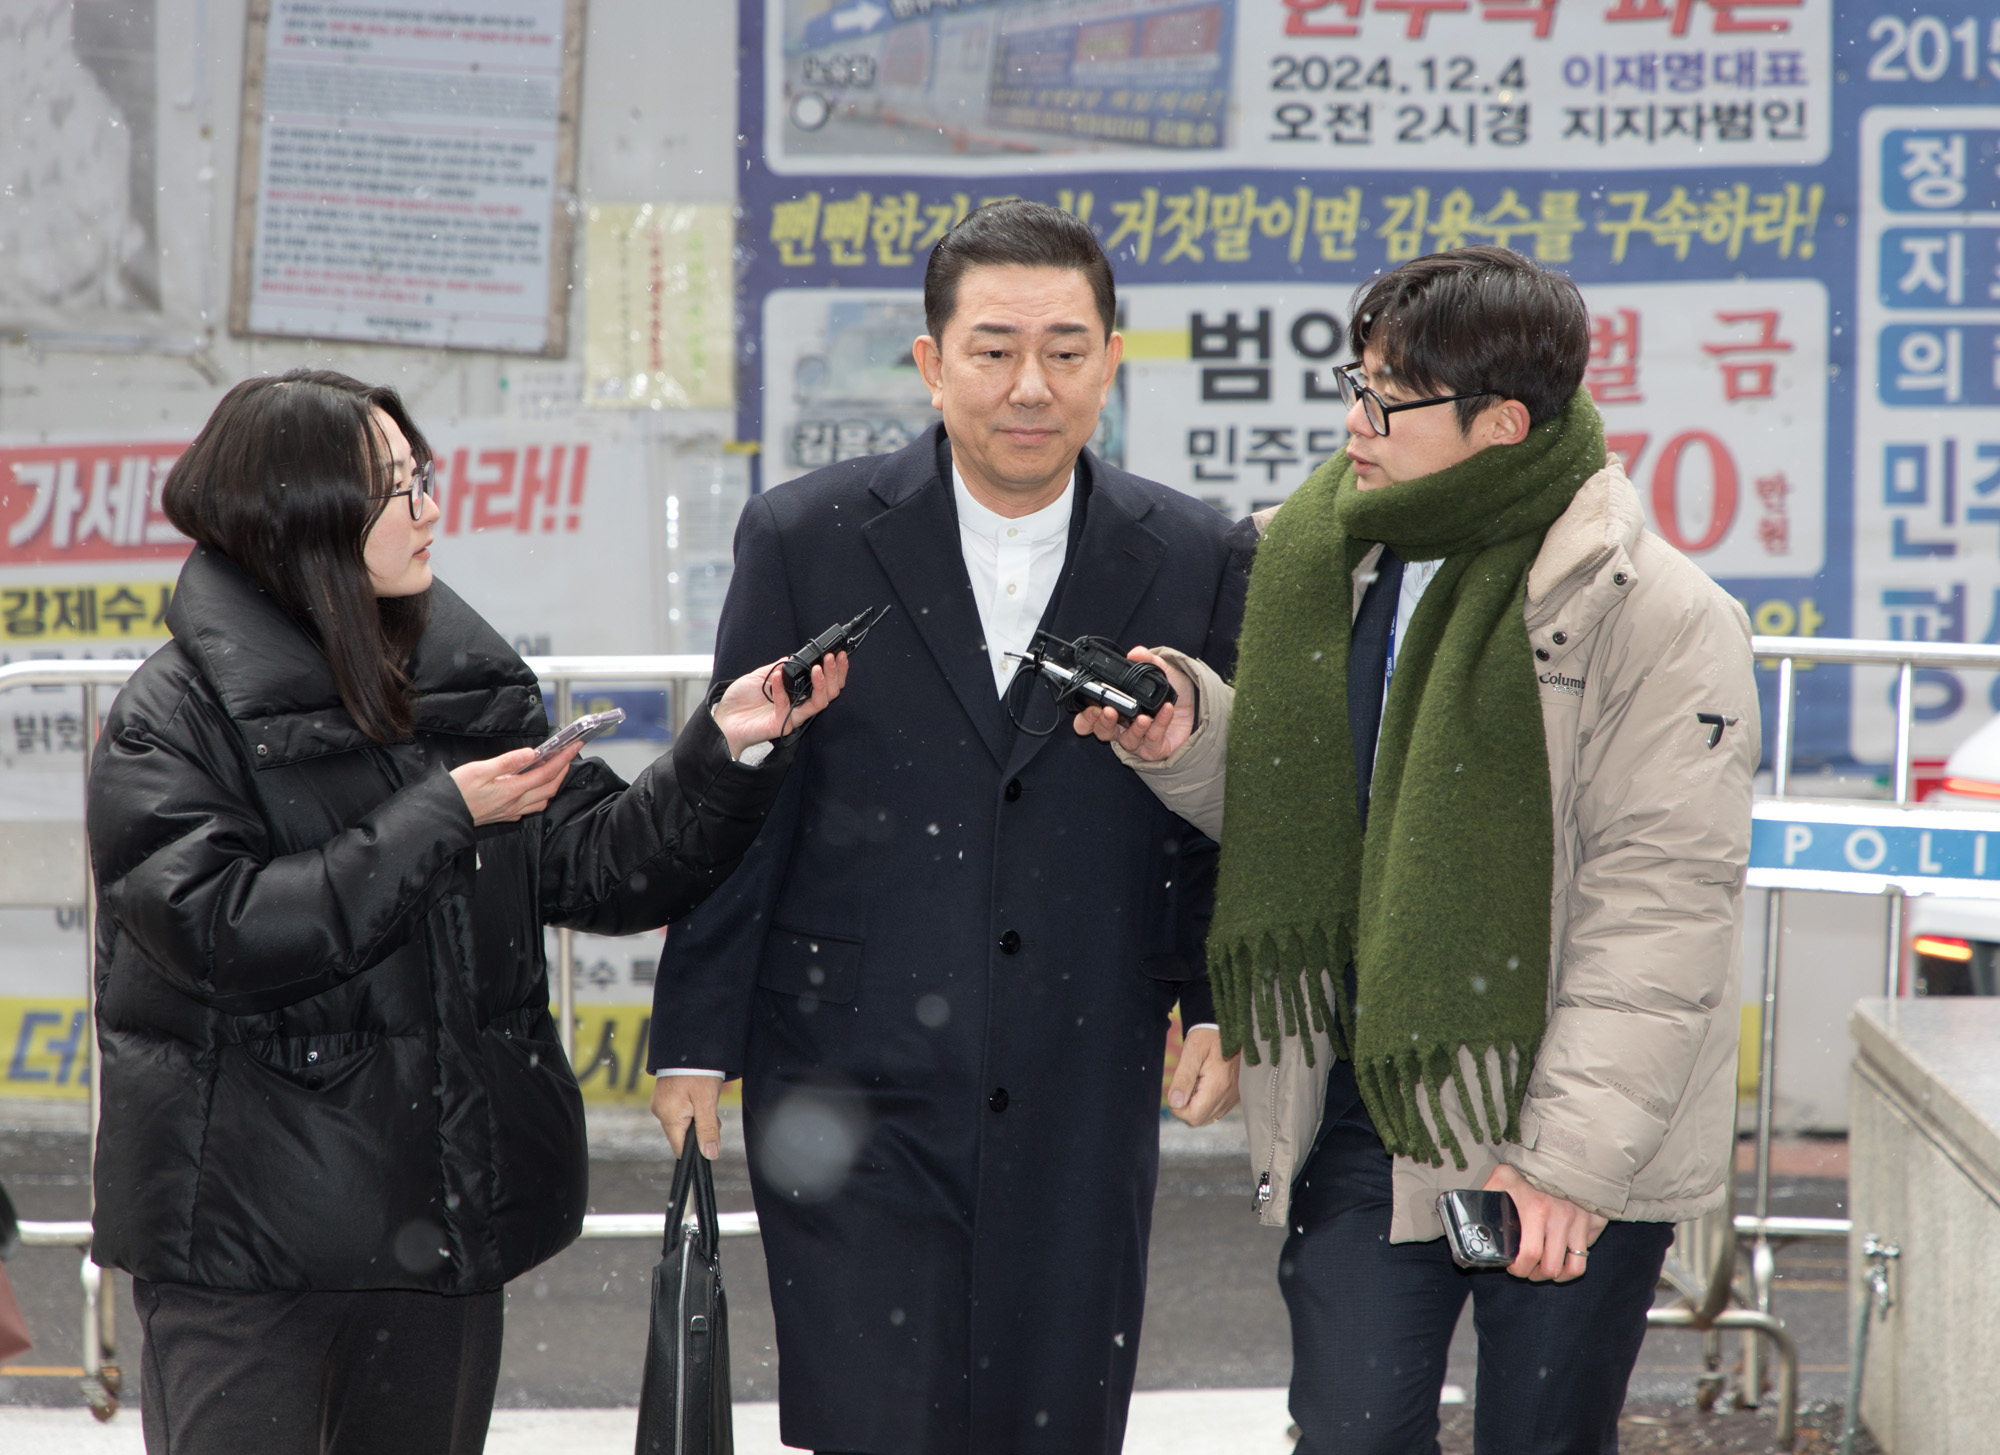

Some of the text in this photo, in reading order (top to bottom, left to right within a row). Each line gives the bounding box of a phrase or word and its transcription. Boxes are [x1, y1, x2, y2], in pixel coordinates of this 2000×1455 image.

[1269, 56, 1526, 94] 2024.12.4
[1563, 50, 1807, 92] 이재명대표
[1269, 104, 1374, 144] 오전
[1397, 102, 1530, 146] 2시경
[1563, 100, 1806, 144] 지지자범인
[1899, 135, 1966, 209] 정
[1105, 187, 1362, 264] 거짓말이면
[1376, 188, 1582, 263] 김용수를
[1597, 184, 1824, 263] 구속하라!
[1899, 232, 1964, 305] 지
[1898, 329, 1963, 402] 의
[2, 584, 177, 636] 강제수
[1782, 824, 1988, 877] POLI
[6, 1010, 90, 1087] 더
